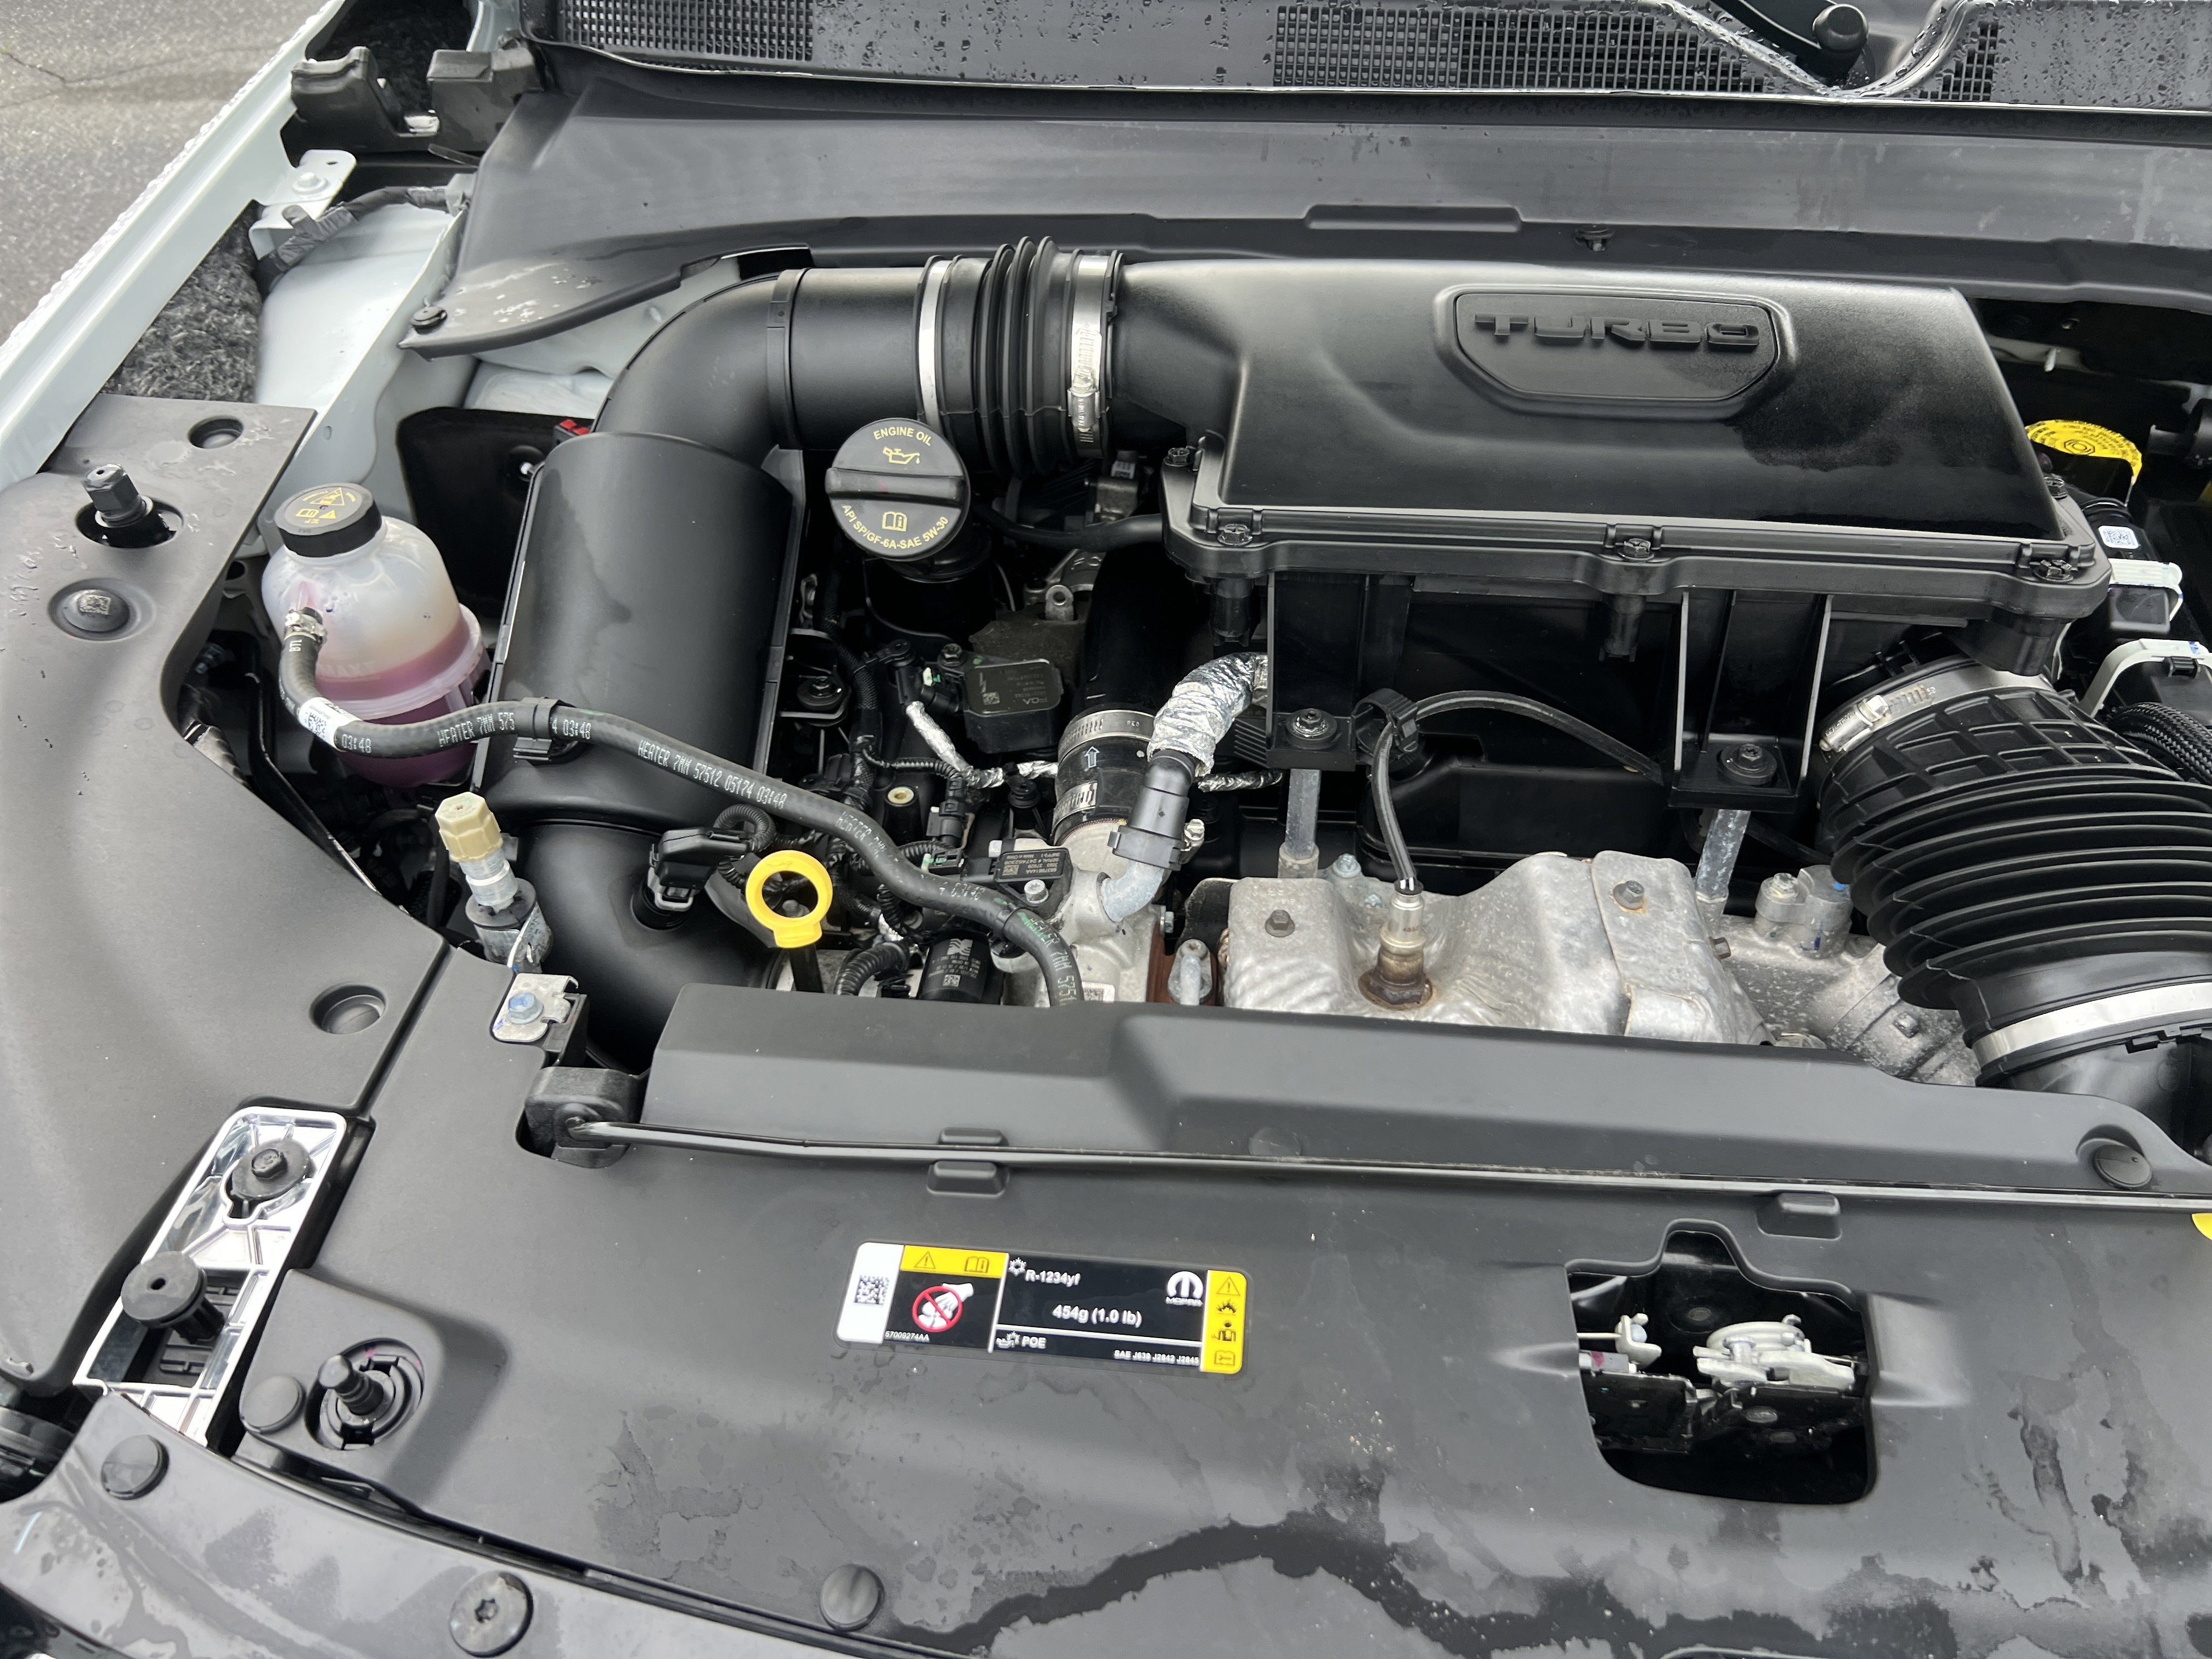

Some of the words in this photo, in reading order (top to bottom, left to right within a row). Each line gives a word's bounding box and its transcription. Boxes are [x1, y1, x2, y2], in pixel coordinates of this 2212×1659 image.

[1474, 312, 1760, 347] TURBO
[873, 426, 915, 440] ENGINE
[916, 431, 932, 447] OIL
[842, 505, 857, 523] API
[853, 521, 923, 549] SP/GF-6A-SAE
[922, 516, 949, 543] 5W-30
[637, 740, 672, 768] HEATER
[673, 754, 692, 775] 7MM
[693, 762, 723, 787] 57512
[1025, 1268, 1081, 1288] R-1234yf
[1165, 1296, 1204, 1307] MOPAR
[1052, 1304, 1090, 1324] 454g
[1091, 1307, 1119, 1324] (1.0
[1122, 1310, 1143, 1328] lb)
[1022, 1336, 1047, 1349] POE
[1114, 1350, 1132, 1361] SAE
[1152, 1353, 1176, 1364] J2842
[1176, 1355, 1199, 1367] J2845
